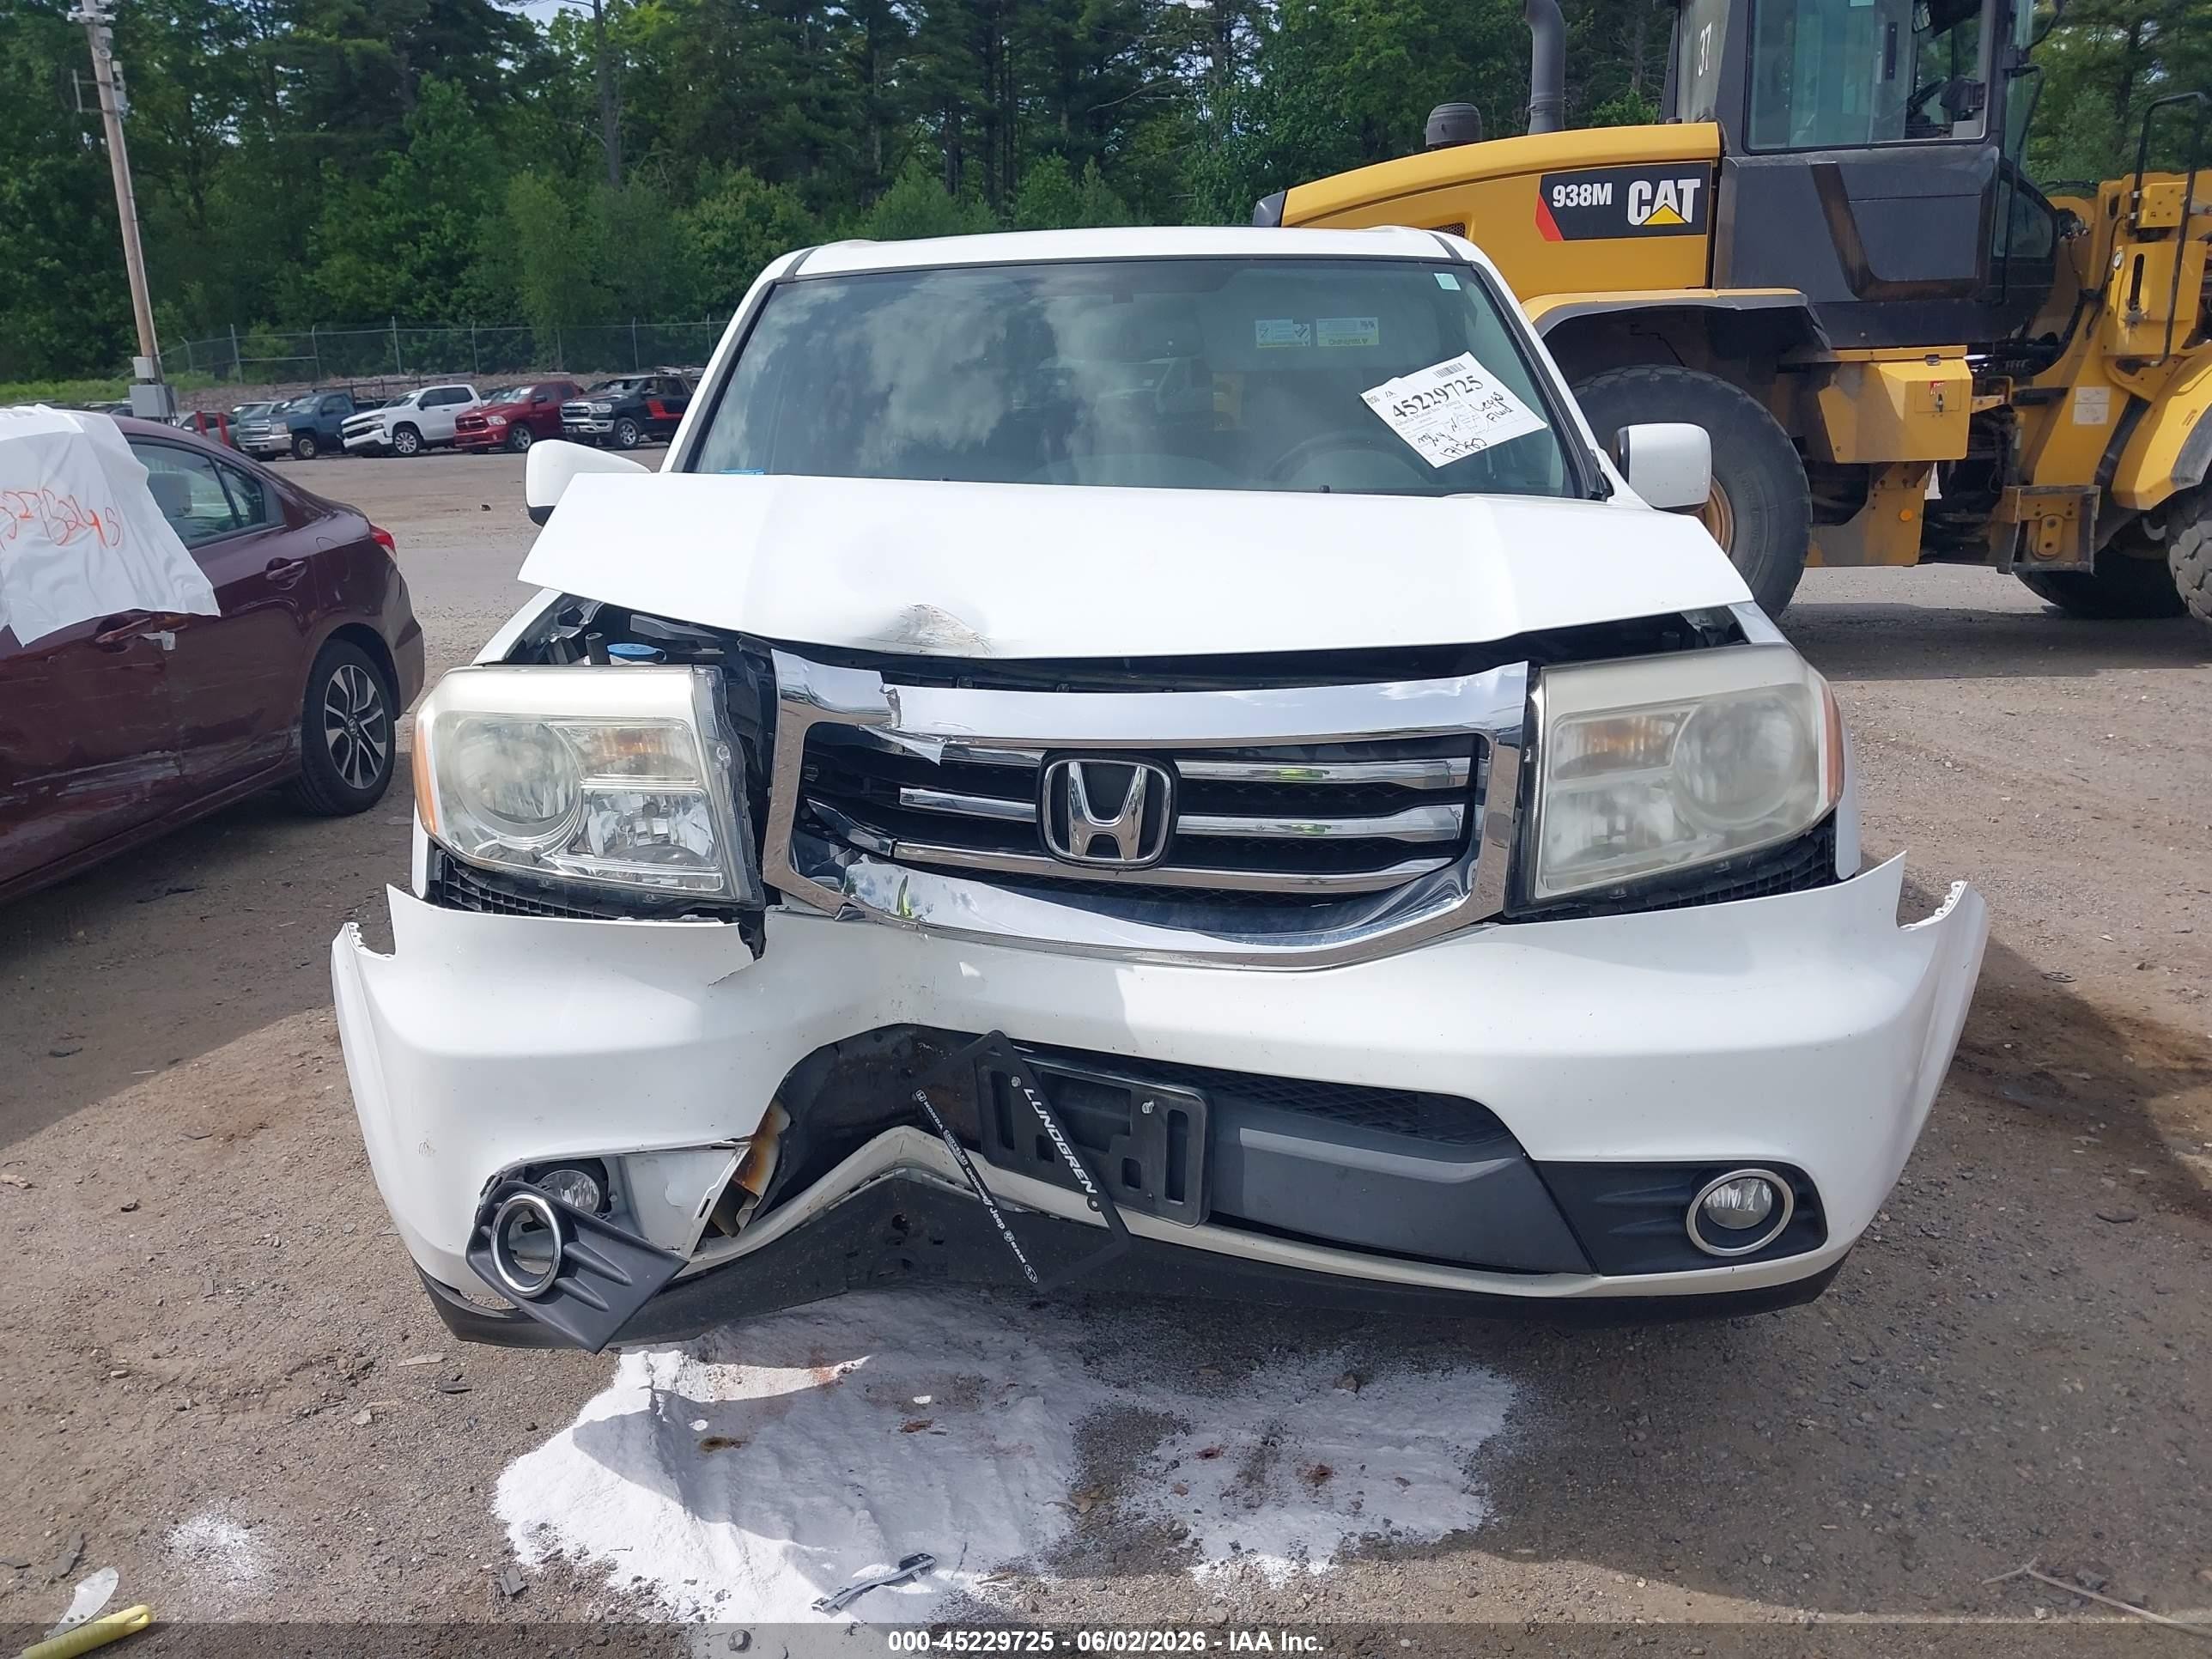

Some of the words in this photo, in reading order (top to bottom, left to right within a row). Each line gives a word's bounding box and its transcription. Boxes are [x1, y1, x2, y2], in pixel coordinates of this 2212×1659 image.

[1698, 21, 1712, 77] 37
[1552, 182, 1613, 208] 938M
[1627, 179, 1701, 226] CAT
[1391, 375, 1484, 418] 45229725
[1023, 1087, 1098, 1195] LUNDGREN
[923, 1101, 944, 1131] HONDA
[944, 1128, 969, 1166] CHRYSLER
[989, 1206, 1006, 1230] Jeep
[1010, 1241, 1027, 1264] RAM
